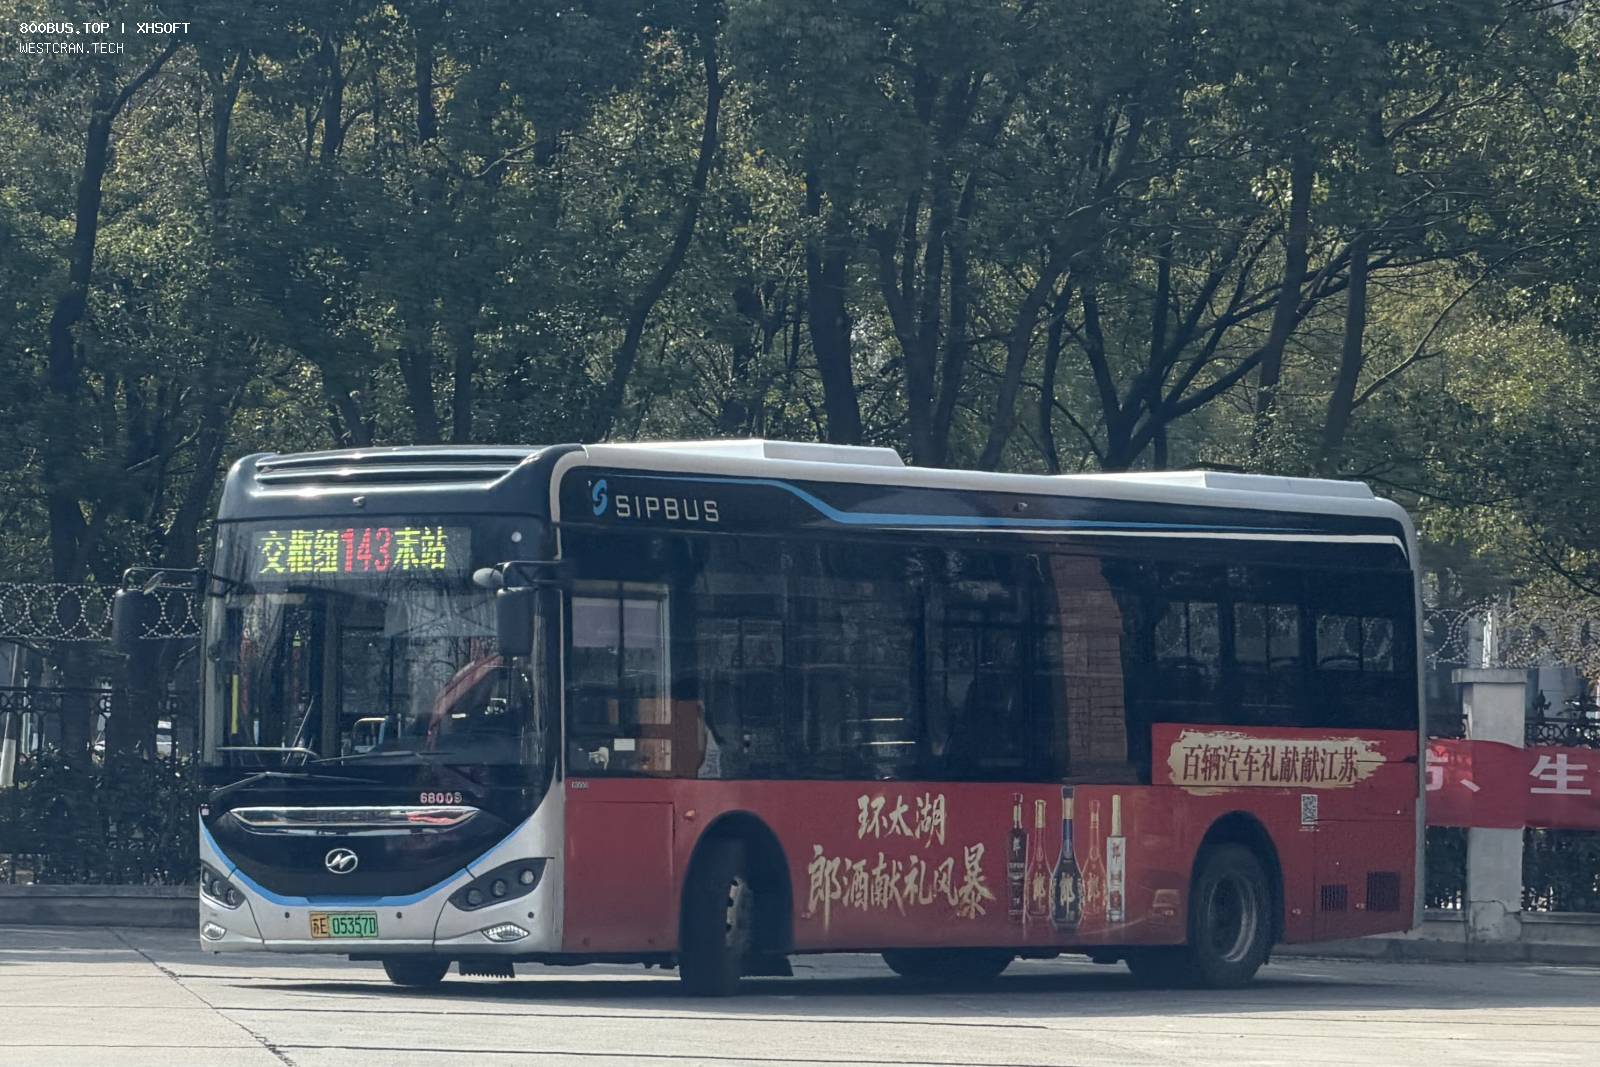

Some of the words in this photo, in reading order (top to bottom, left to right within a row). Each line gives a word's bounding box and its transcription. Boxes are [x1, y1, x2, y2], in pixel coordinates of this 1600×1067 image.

[615, 495, 720, 522] SIPBUS
[857, 793, 946, 848] 环太湖
[808, 843, 996, 931] 郎酒献礼风暴
